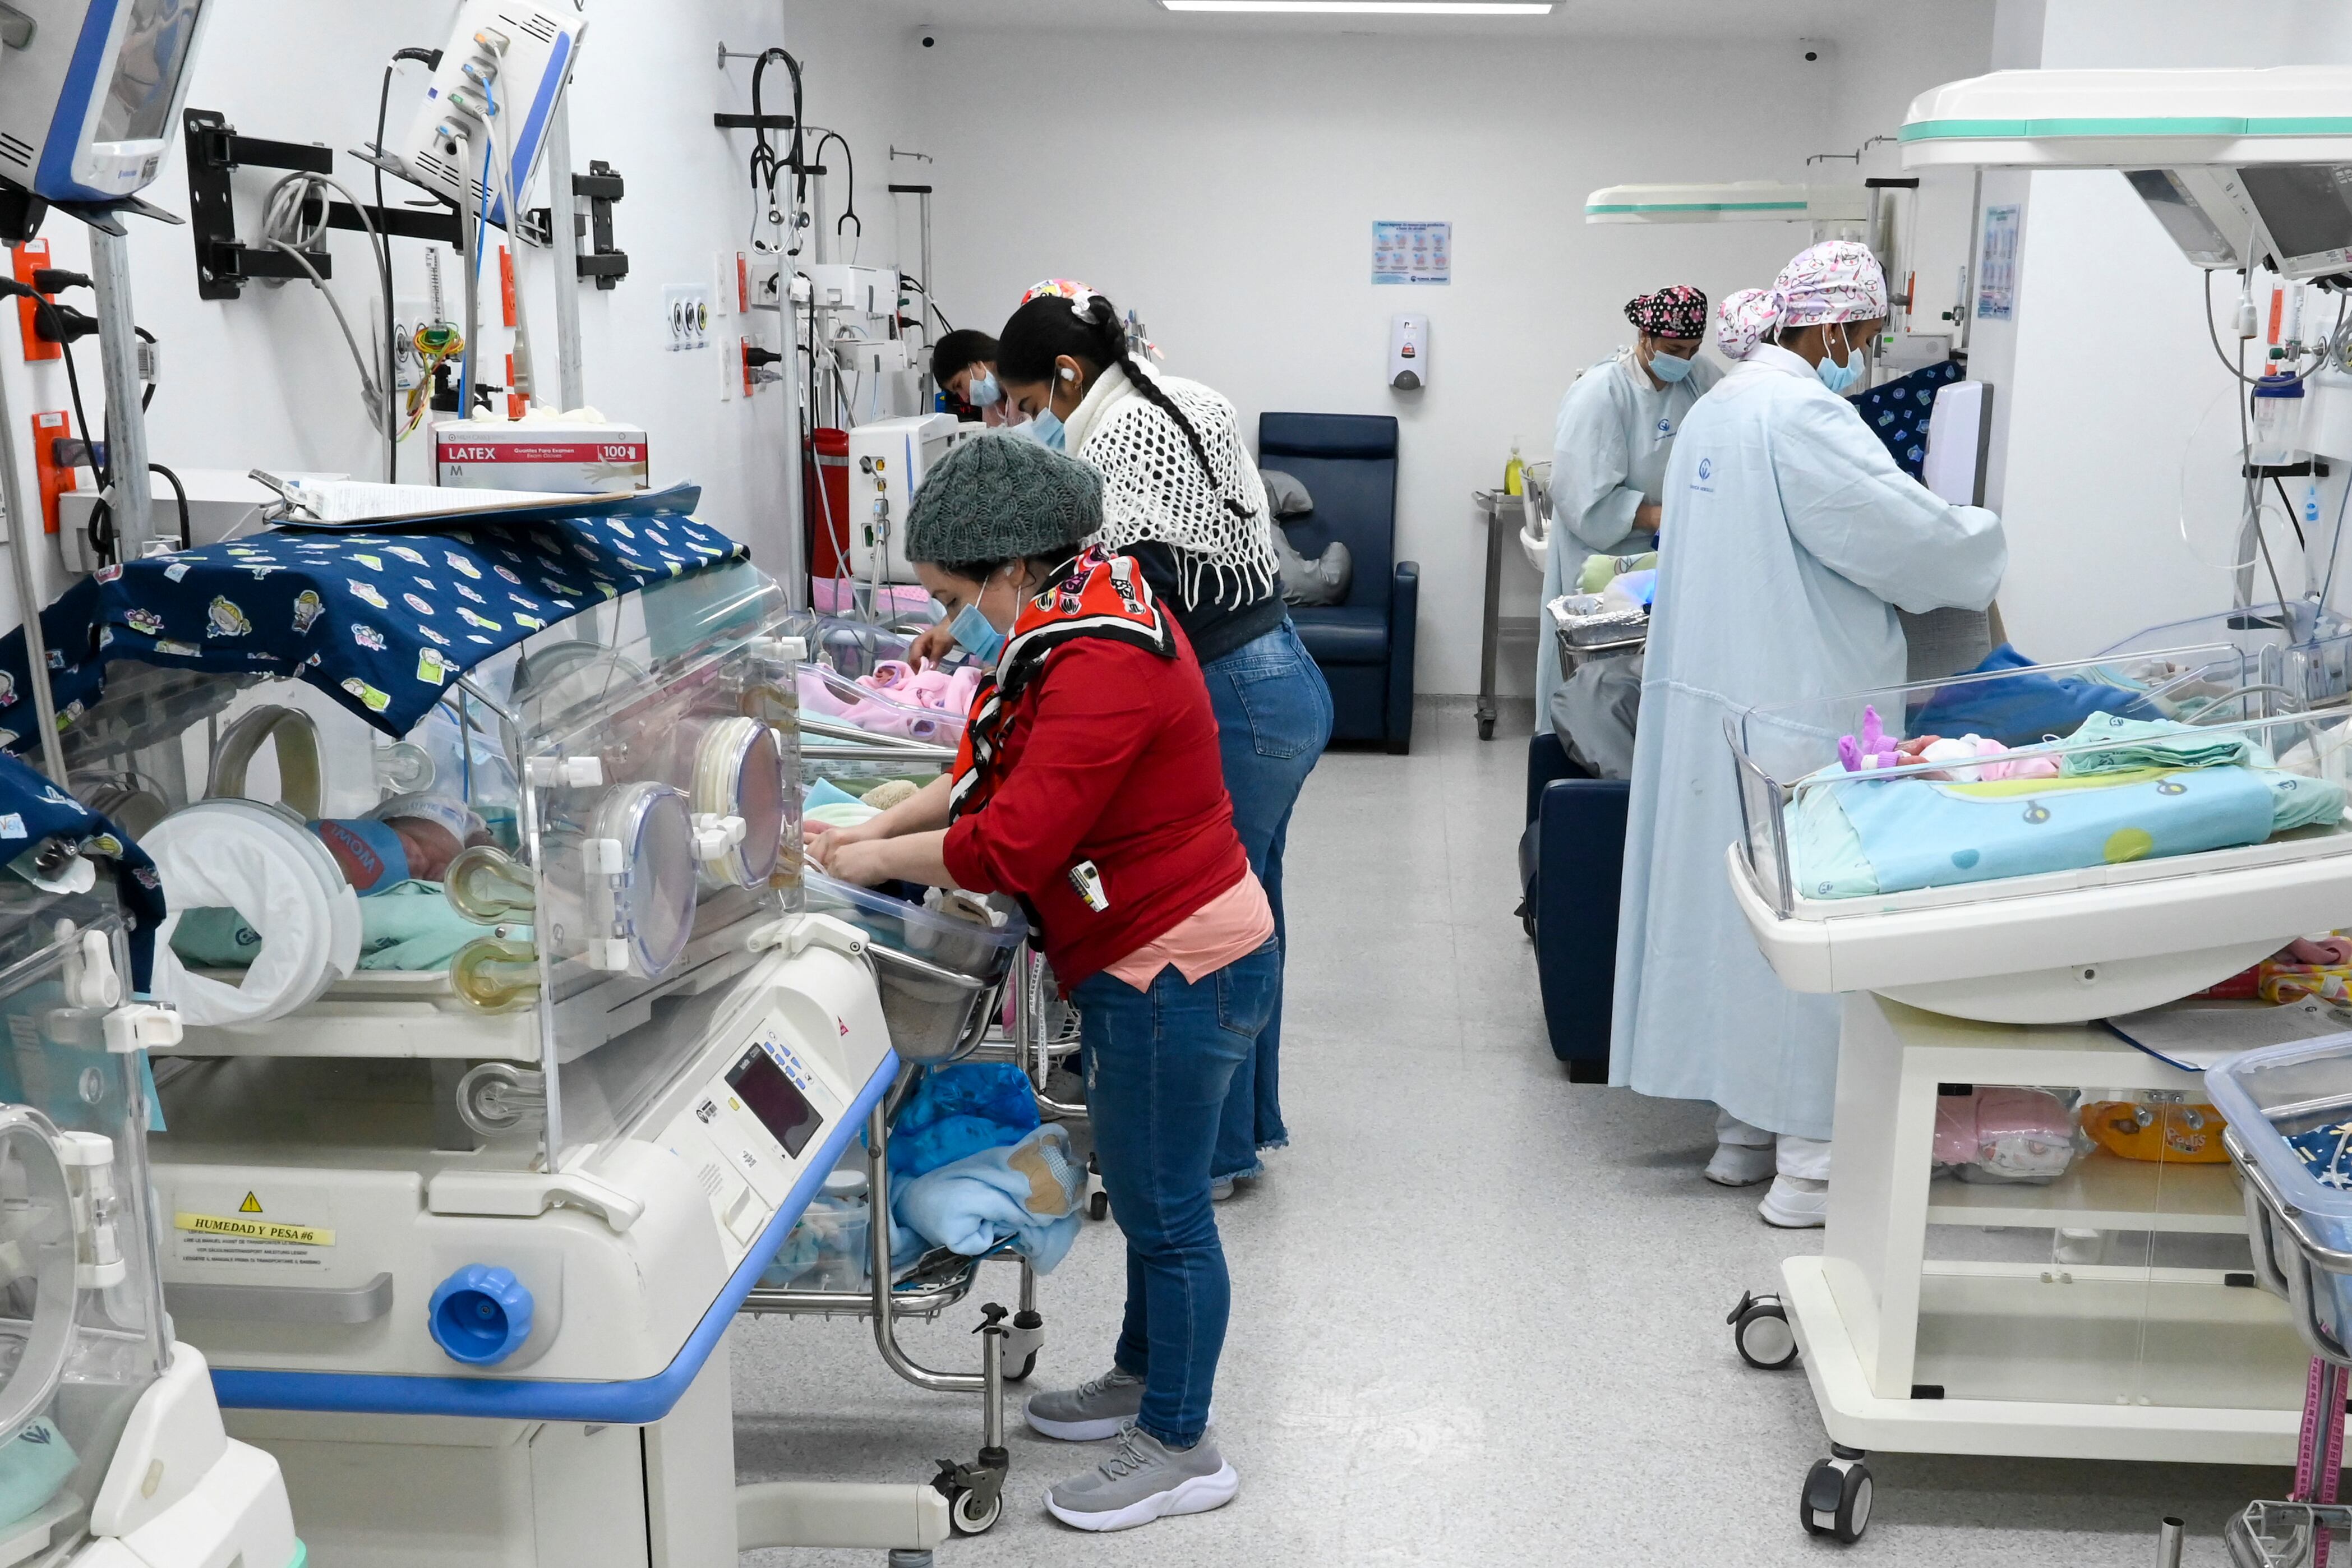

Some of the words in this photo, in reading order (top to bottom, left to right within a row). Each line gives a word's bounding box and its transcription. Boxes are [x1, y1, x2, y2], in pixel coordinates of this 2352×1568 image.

[449, 448, 496, 460] LATEX
[604, 446, 626, 458] 100
[450, 465, 463, 476] M
[195, 1218, 255, 1234] HUMEDAD
[259, 1226, 266, 1235] Y
[270, 1228, 298, 1239] PESA
[301, 1232, 313, 1240] #6
